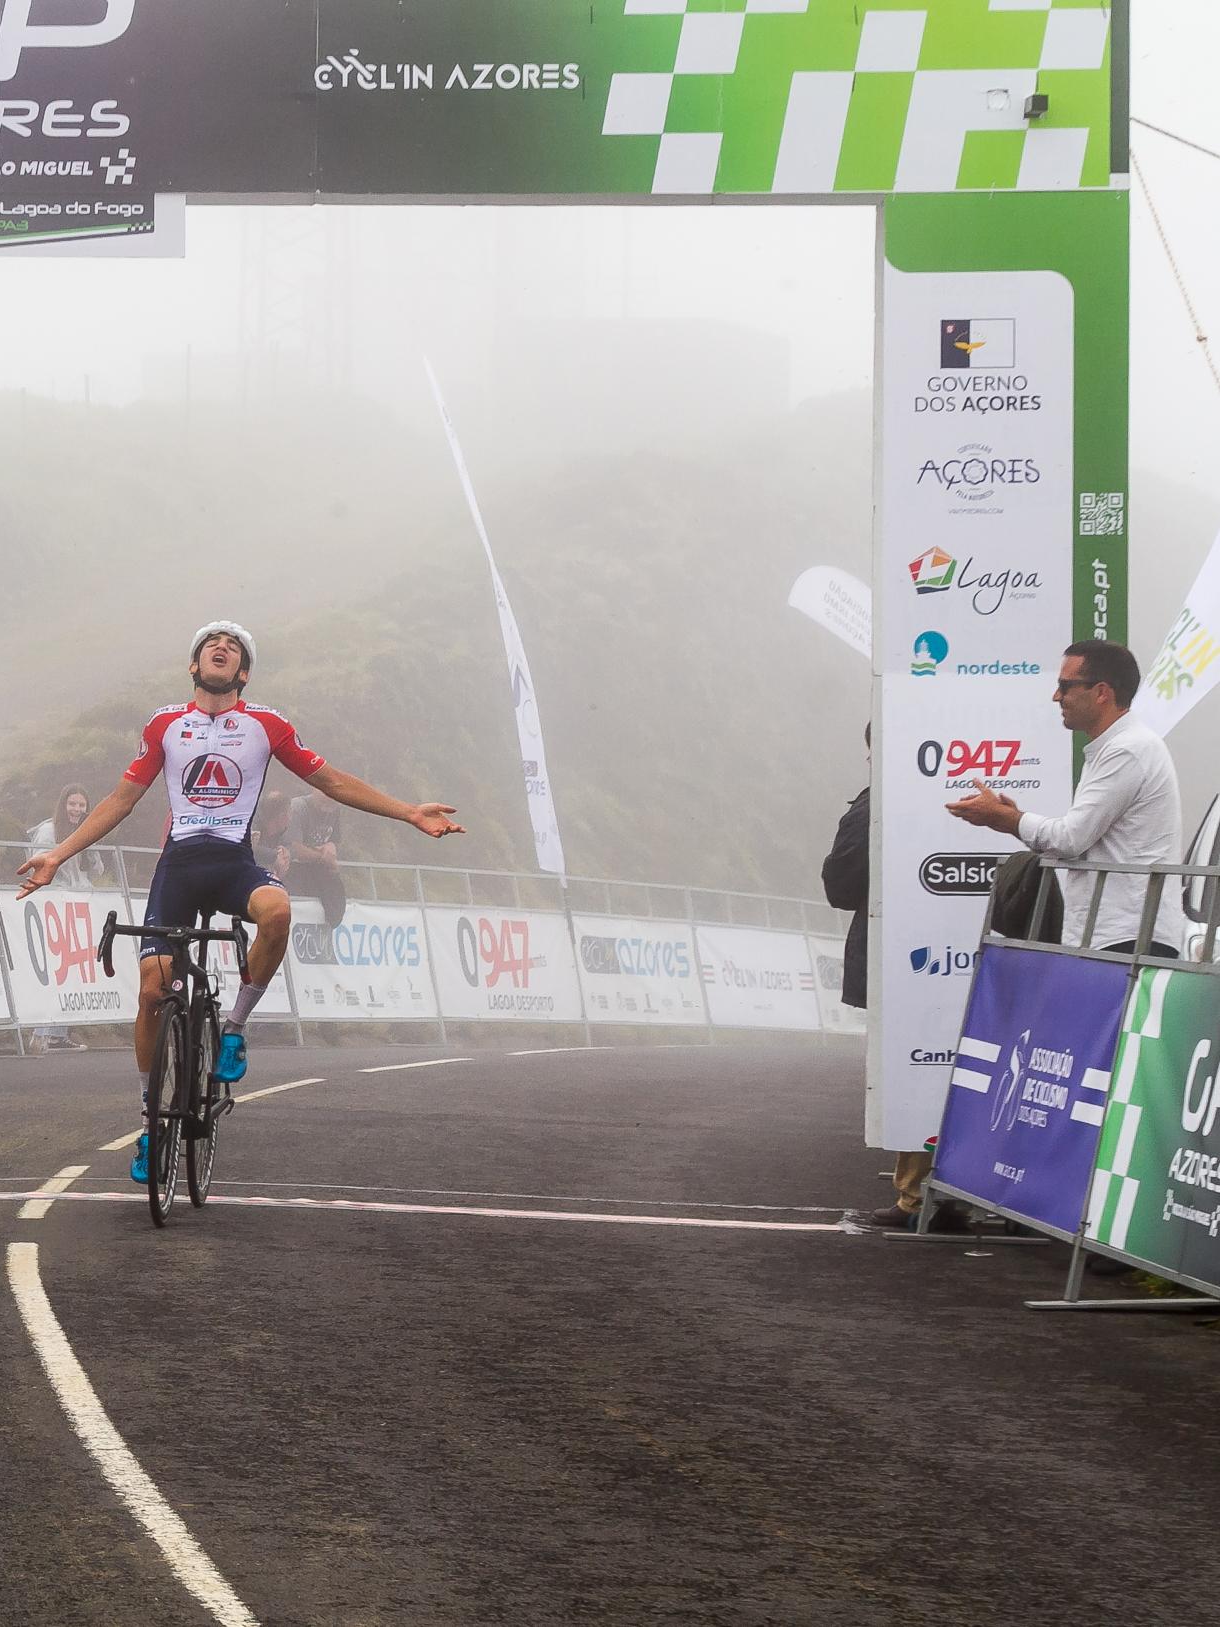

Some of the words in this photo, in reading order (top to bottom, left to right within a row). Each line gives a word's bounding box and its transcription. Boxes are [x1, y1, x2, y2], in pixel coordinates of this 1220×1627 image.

[444, 63, 580, 89] AZORES
[20, 160, 93, 176] MIGUEL
[0, 201, 62, 218] Lagoa
[66, 201, 90, 215] do
[94, 201, 144, 218] Fogo
[927, 375, 1028, 392] GOVERNO
[914, 396, 956, 413] DOS
[961, 395, 1041, 414] AÇORES
[916, 458, 1041, 490] AÇORES
[957, 556, 1043, 615] Lagoa
[1092, 558, 1111, 641] aca.pt
[957, 660, 1041, 675] nordeste
[917, 740, 1022, 777] 0947
[945, 780, 979, 789] LAGO
[984, 779, 1041, 789] DESPORTO
[335, 923, 421, 967] azores
[58, 992, 86, 1011] LAGOA
[86, 991, 121, 1011] DESPORTO
[488, 994, 515, 1010] LAGOA
[516, 995, 554, 1012] DESPORTO
[910, 1048, 956, 1063] Can
[1169, 1148, 1220, 1193] AZORE
